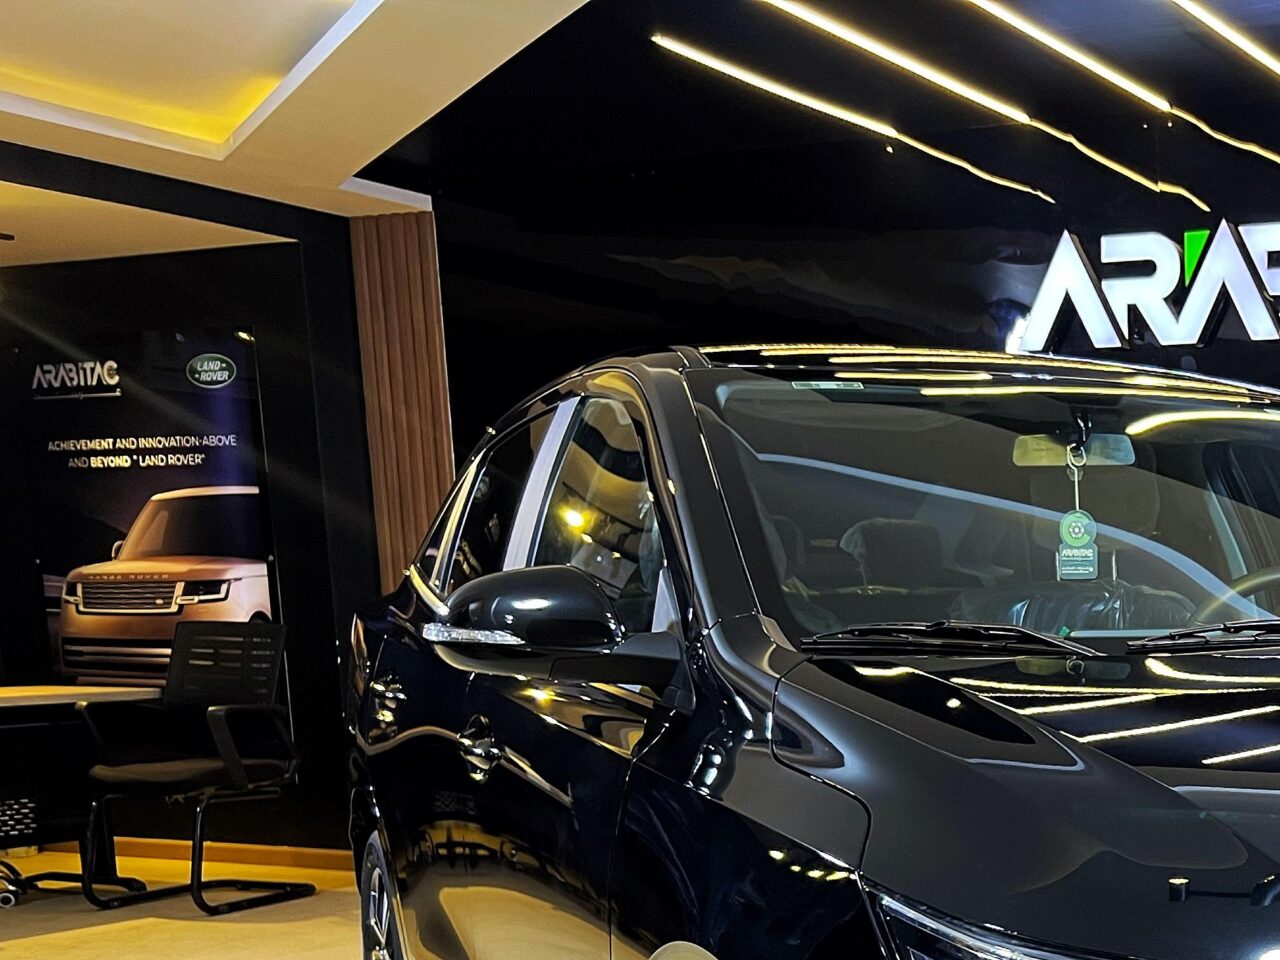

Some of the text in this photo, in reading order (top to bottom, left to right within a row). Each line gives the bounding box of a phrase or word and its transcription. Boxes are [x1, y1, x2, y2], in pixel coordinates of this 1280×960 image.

[32, 360, 119, 389] ARABITAC
[48, 438, 114, 451] ACHIEVEMENT
[115, 437, 137, 449] AND
[68, 457, 89, 468] AND
[90, 455, 131, 468] BEYOND
